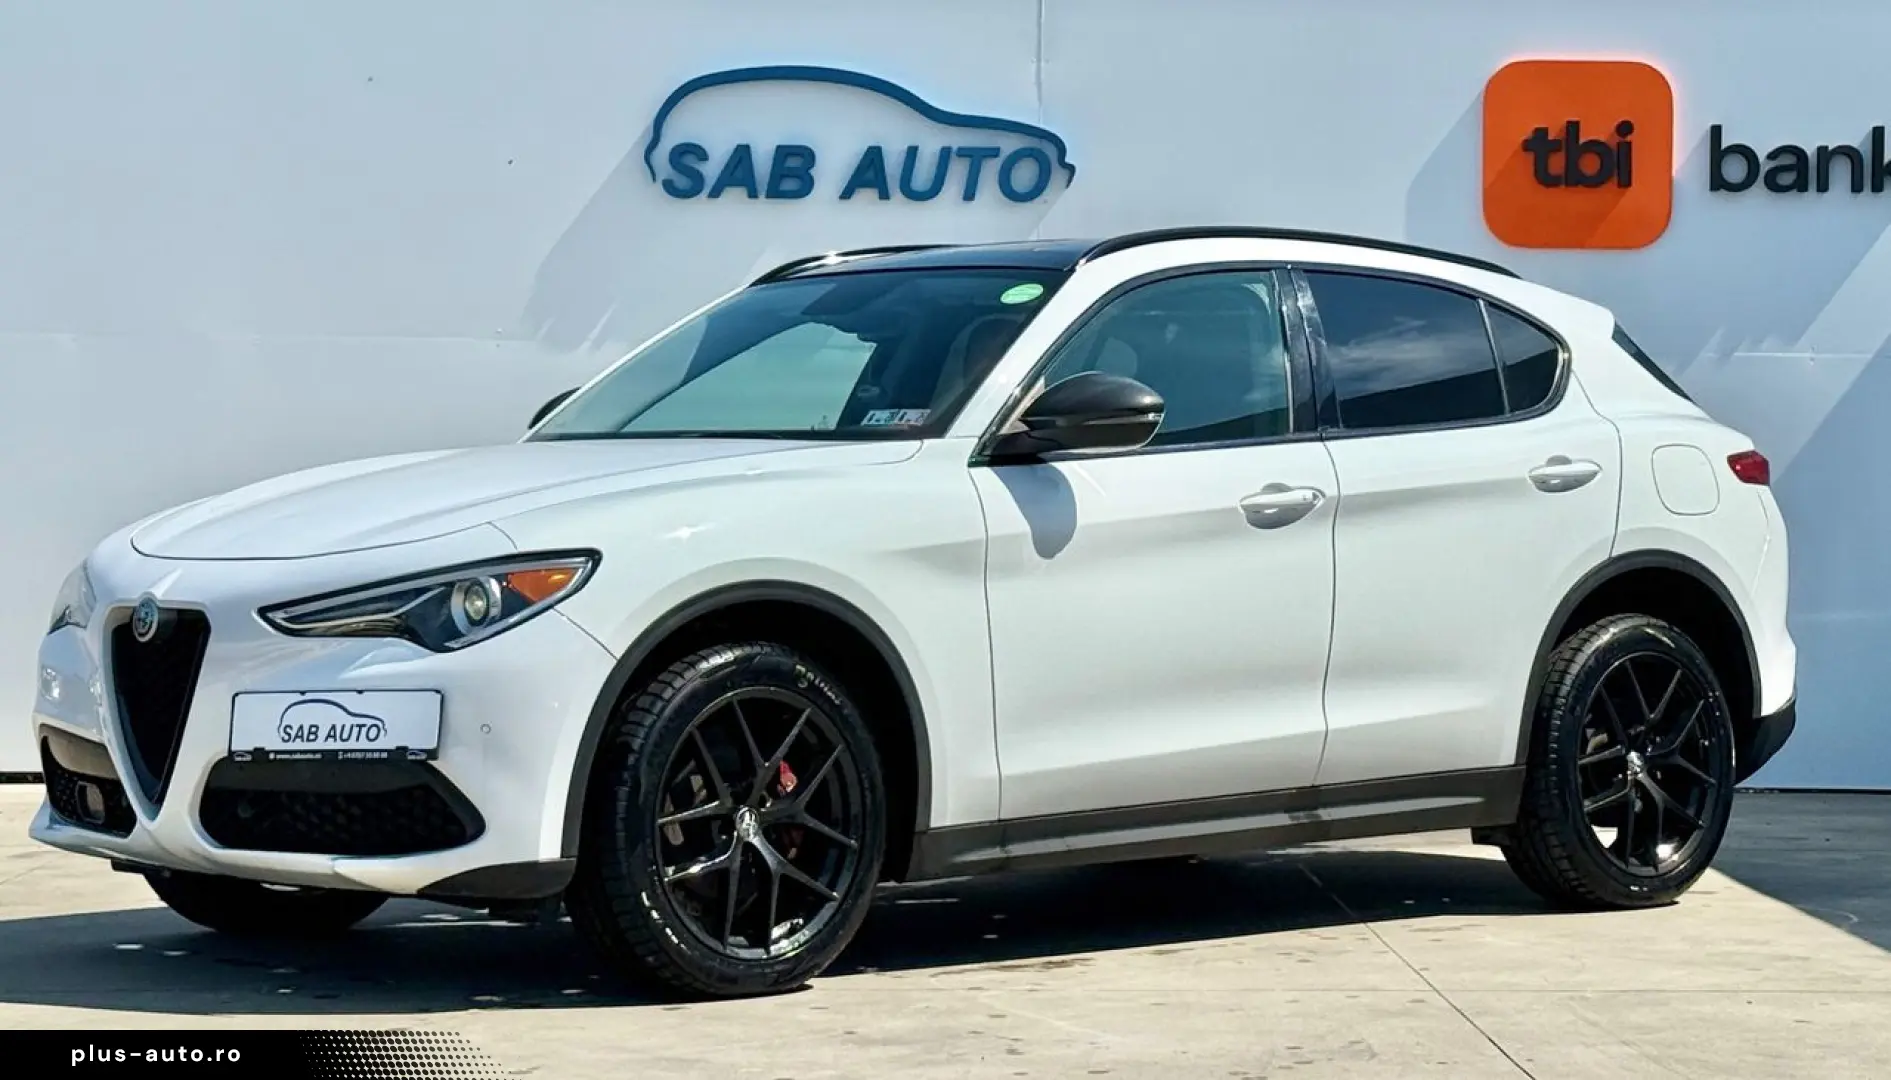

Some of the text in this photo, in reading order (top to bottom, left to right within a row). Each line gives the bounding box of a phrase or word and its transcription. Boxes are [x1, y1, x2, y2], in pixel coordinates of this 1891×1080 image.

[661, 143, 1053, 202] SAB AUTO
[1522, 120, 1635, 189] tbi
[281, 723, 381, 743] SAB AUTO
